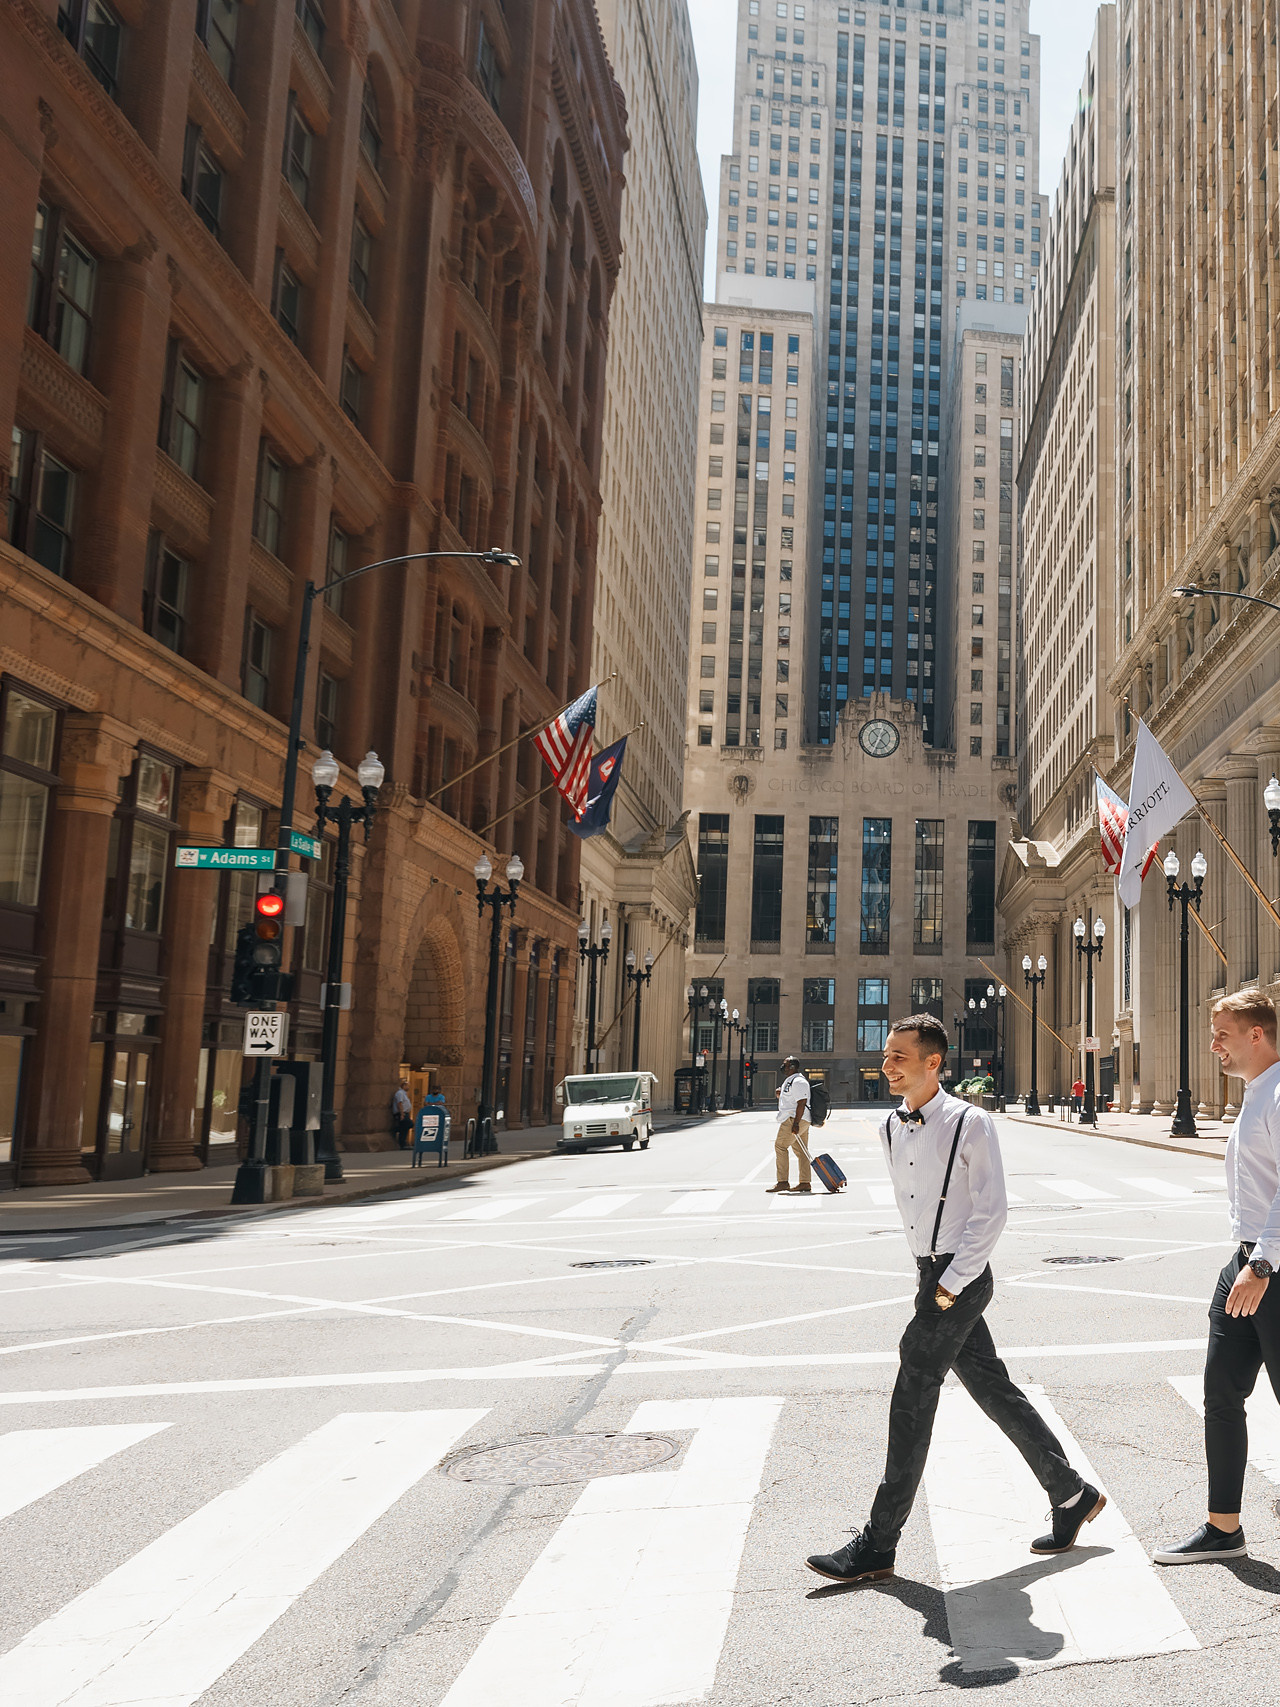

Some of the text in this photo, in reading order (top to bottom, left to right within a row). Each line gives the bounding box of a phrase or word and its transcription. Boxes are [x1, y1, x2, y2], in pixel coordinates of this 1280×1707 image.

[768, 777, 988, 798] CHICAGO BOARD OF TRADE
[210, 851, 257, 864] Adams
[261, 855, 271, 863] St
[251, 1016, 278, 1026] ONE
[250, 1028, 278, 1038] WAY
